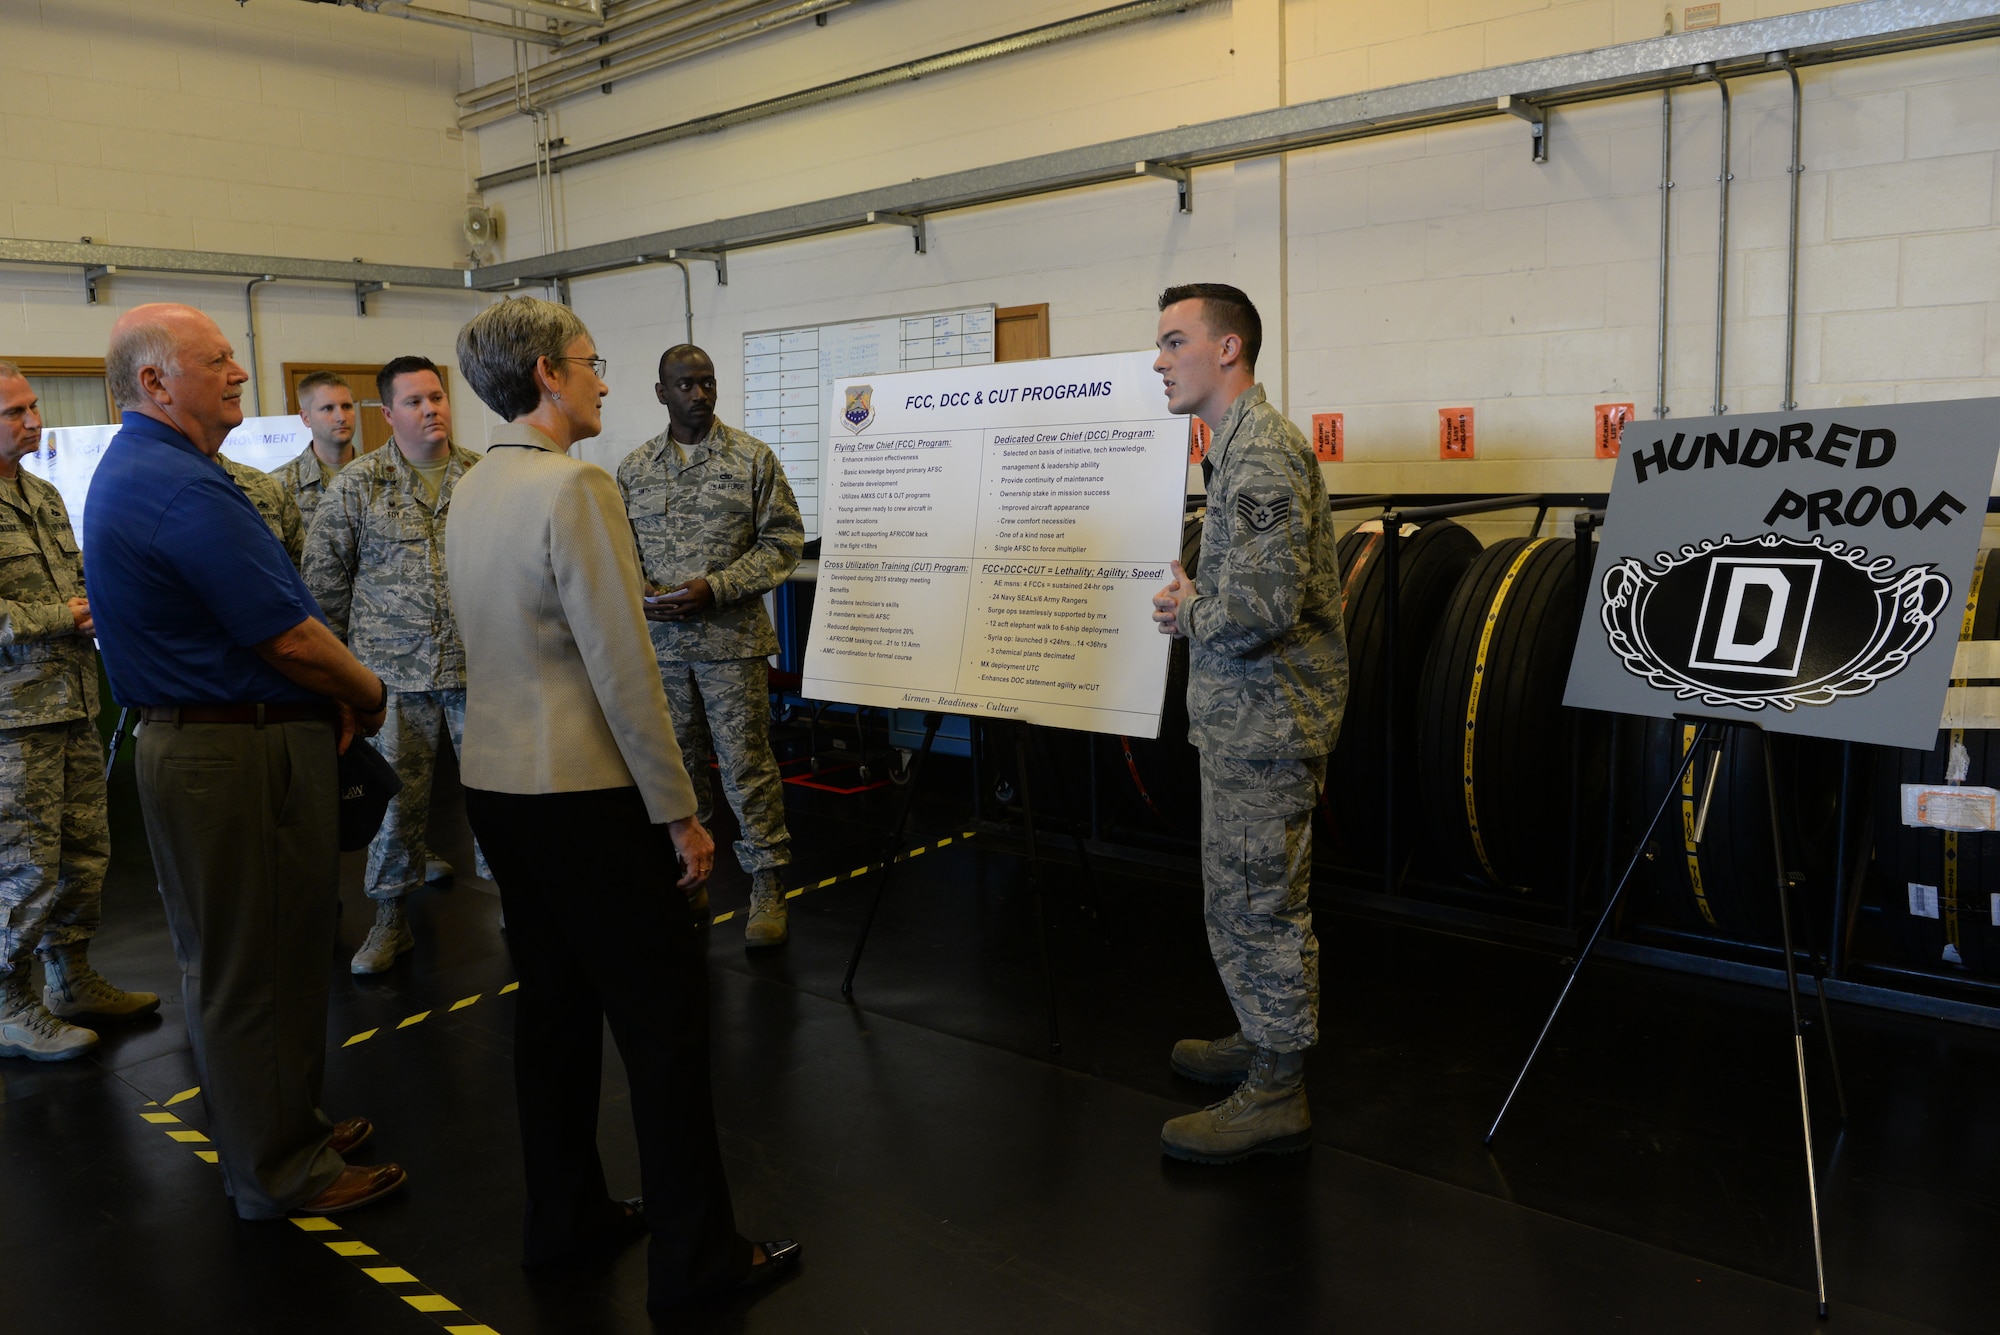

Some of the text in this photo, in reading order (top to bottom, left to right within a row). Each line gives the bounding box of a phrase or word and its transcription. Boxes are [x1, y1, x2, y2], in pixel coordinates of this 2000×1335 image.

[906, 382, 1112, 410] FCC, DCC & CUT PROGRAMS
[994, 429, 1154, 444] Dedicated Crew Chief (DCC) Program:
[834, 439, 952, 452] Flying Crew Chief (FCC) Program:
[1109, 445, 1146, 454] knowledge,
[1632, 422, 1896, 483] HUNDRED
[1763, 486, 1966, 531] PROOF
[995, 545, 1013, 553] Single
[824, 561, 968, 573] Cross Utilization Training (CUT) Program:
[982, 564, 1046, 574] FCC+DCC+CUT
[1055, 566, 1095, 577] Lethality;
[1097, 568, 1128, 578] Agility;
[1132, 568, 1164, 579] Speed!
[1001, 594, 1016, 602] Navy
[1044, 596, 1061, 604] Army
[1062, 596, 1088, 606] Rangers
[988, 606, 1005, 615] Surge
[1019, 609, 1053, 618] seamlessly
[1714, 567, 1791, 662] D
[1081, 626, 1119, 635] deployment
[988, 634, 1003, 642] Syria
[1043, 652, 1076, 660] decimated
[991, 662, 1026, 671] deployment
[981, 674, 1010, 683] Enhances
[1057, 682, 1077, 691] agility
[902, 694, 1019, 713] Airmen Readiness Culture
